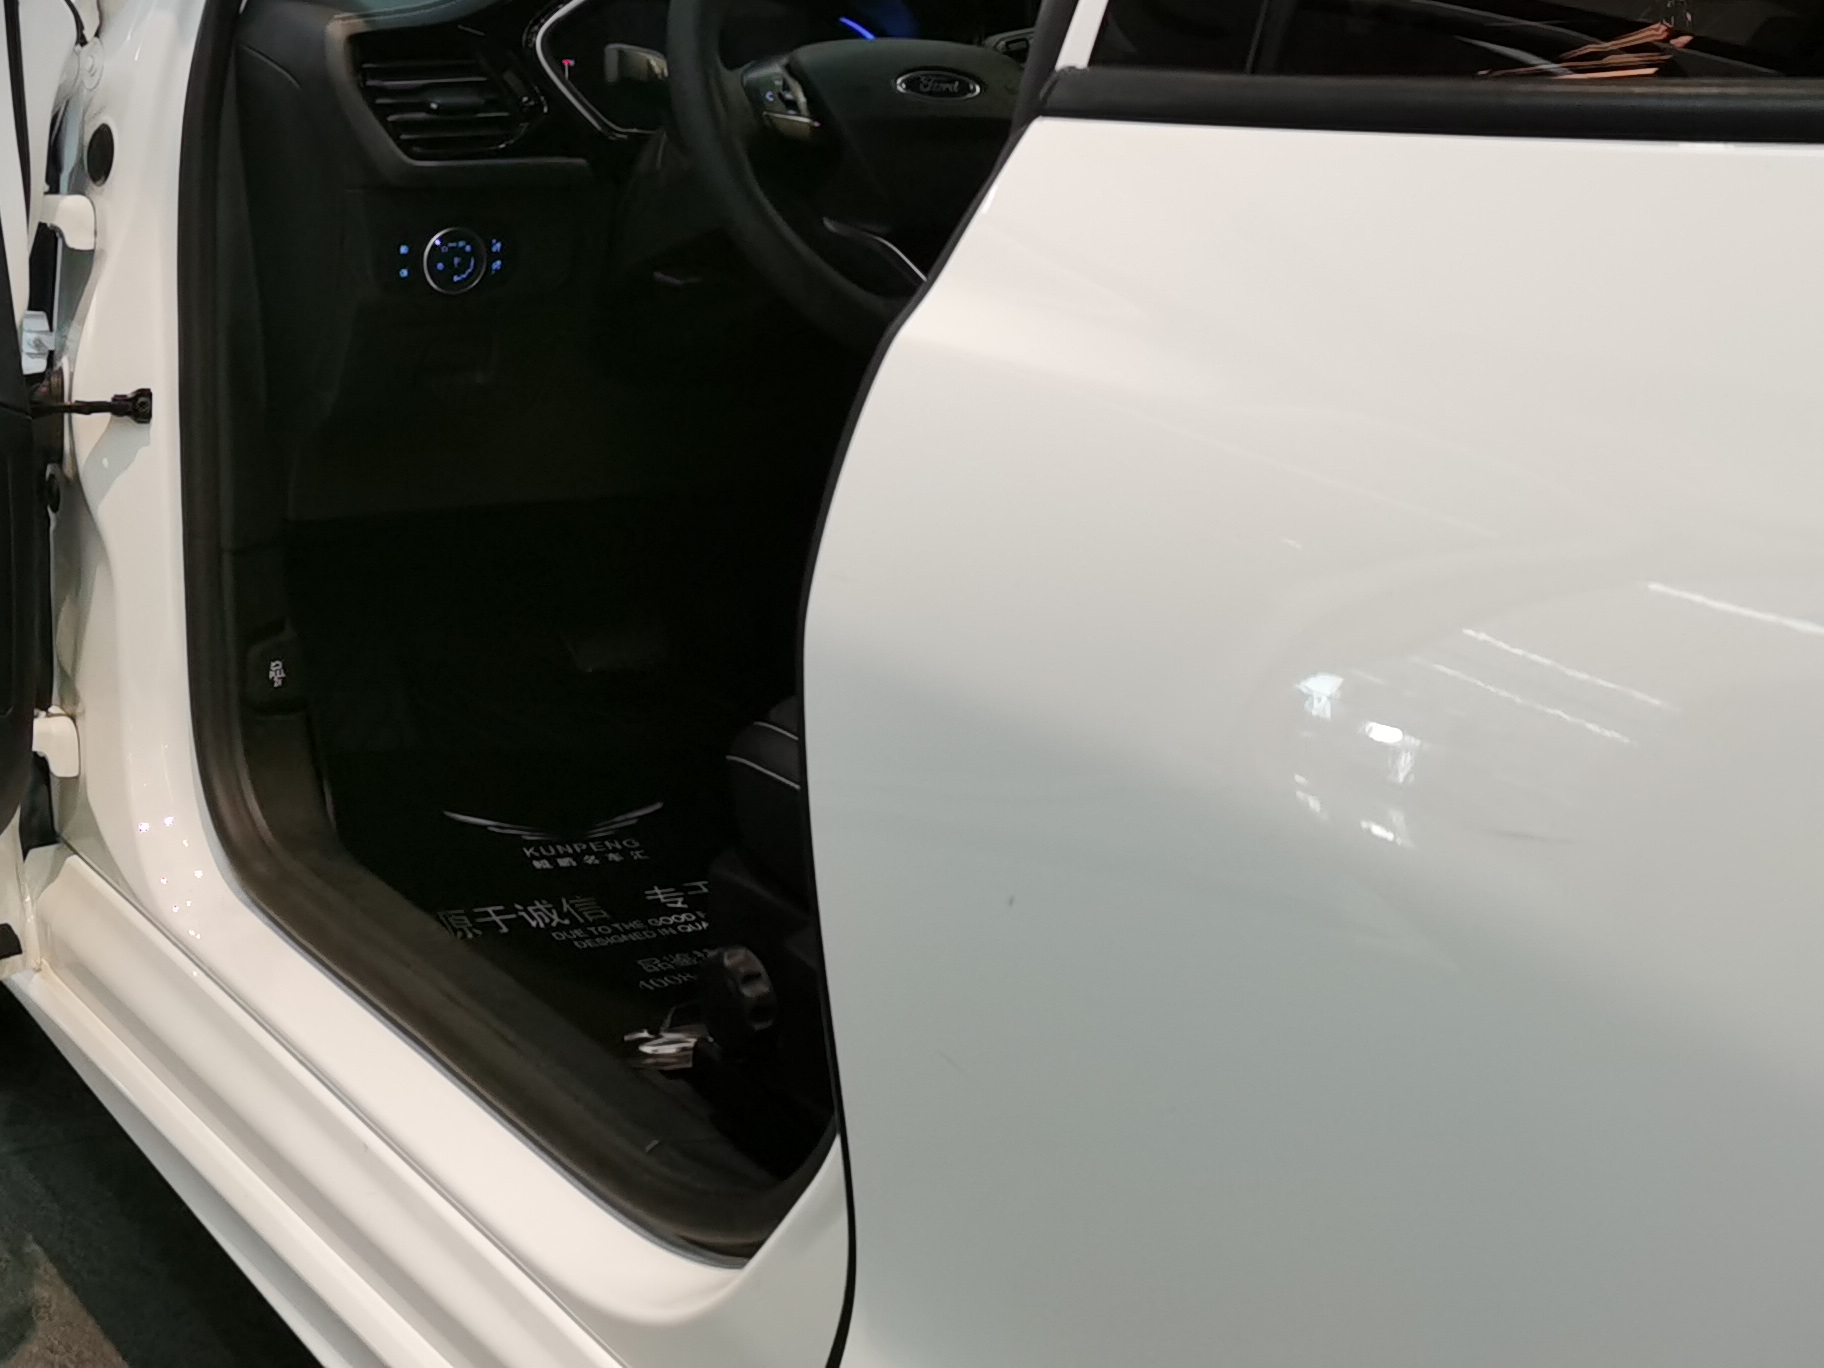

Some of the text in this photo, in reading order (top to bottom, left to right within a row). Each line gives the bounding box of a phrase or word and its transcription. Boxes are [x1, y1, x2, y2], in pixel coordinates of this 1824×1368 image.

[522, 838, 641, 858] KUNPENG
[551, 925, 589, 941] DUE
[610, 919, 646, 933] THE
[646, 912, 697, 927] GOOD
[572, 930, 657, 949] DESIGNED
